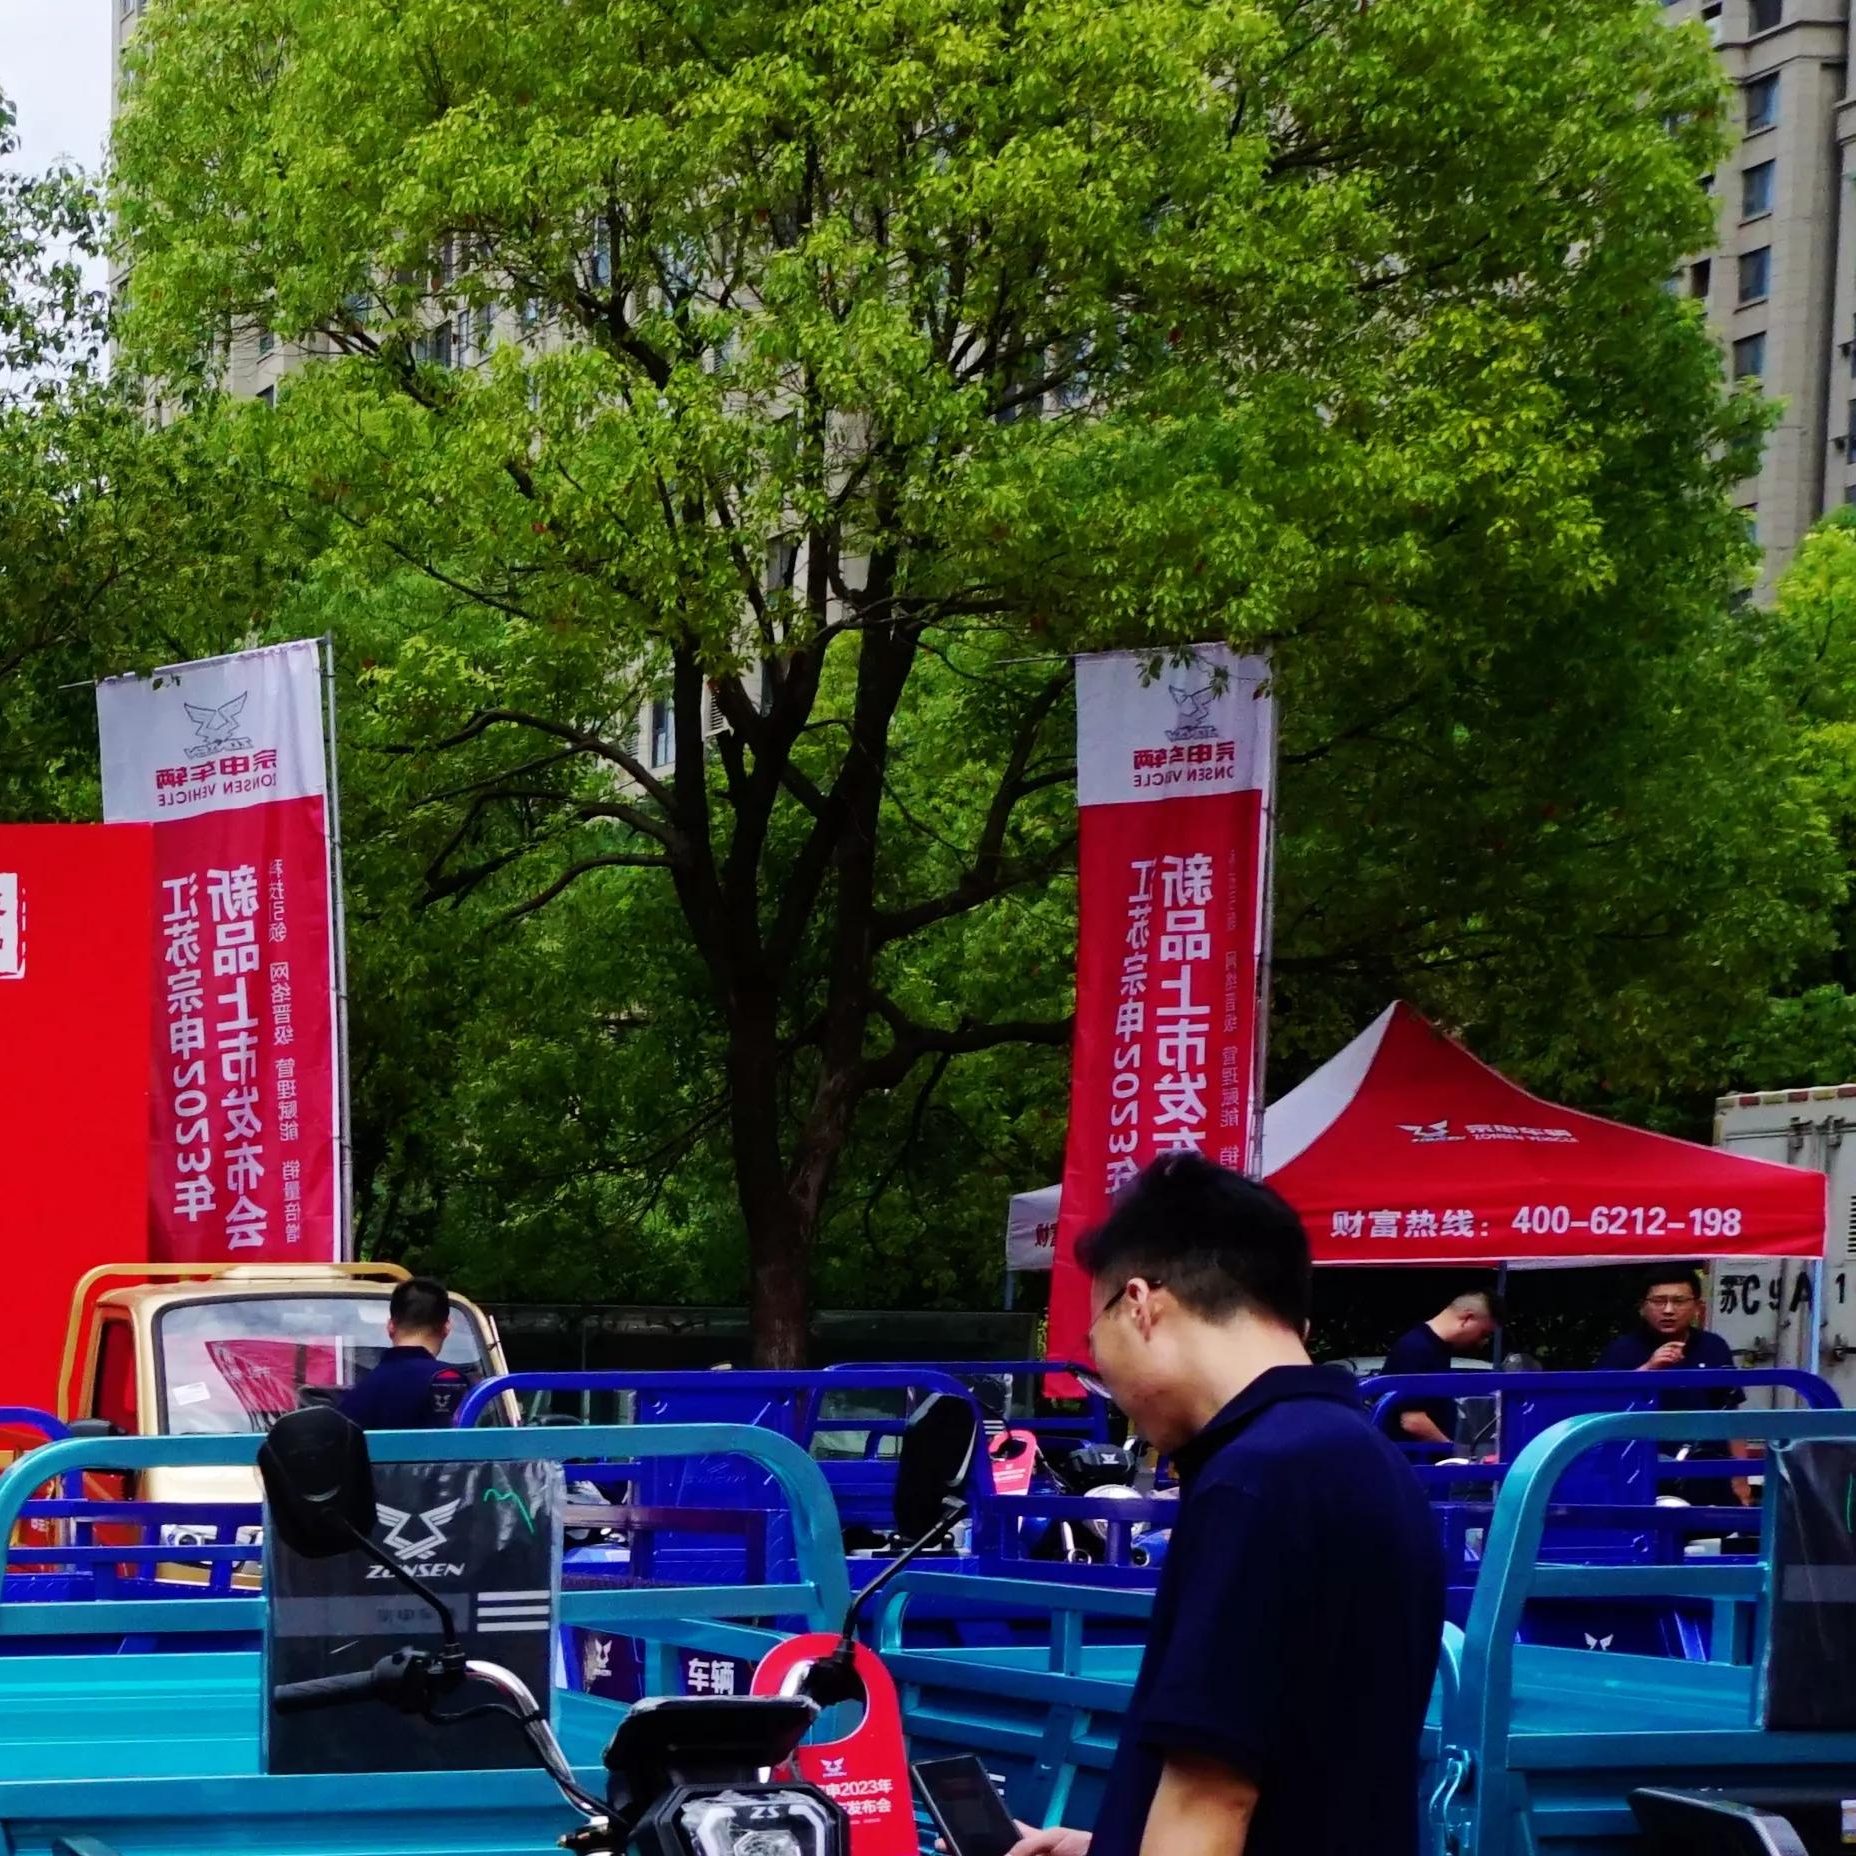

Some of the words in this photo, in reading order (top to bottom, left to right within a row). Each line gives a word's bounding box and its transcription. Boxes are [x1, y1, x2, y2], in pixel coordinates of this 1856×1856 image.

[1512, 1205, 1741, 1237] 400-6212-198
[687, 1657, 736, 1696] 车辆
[749, 1805, 781, 1819] ZS
